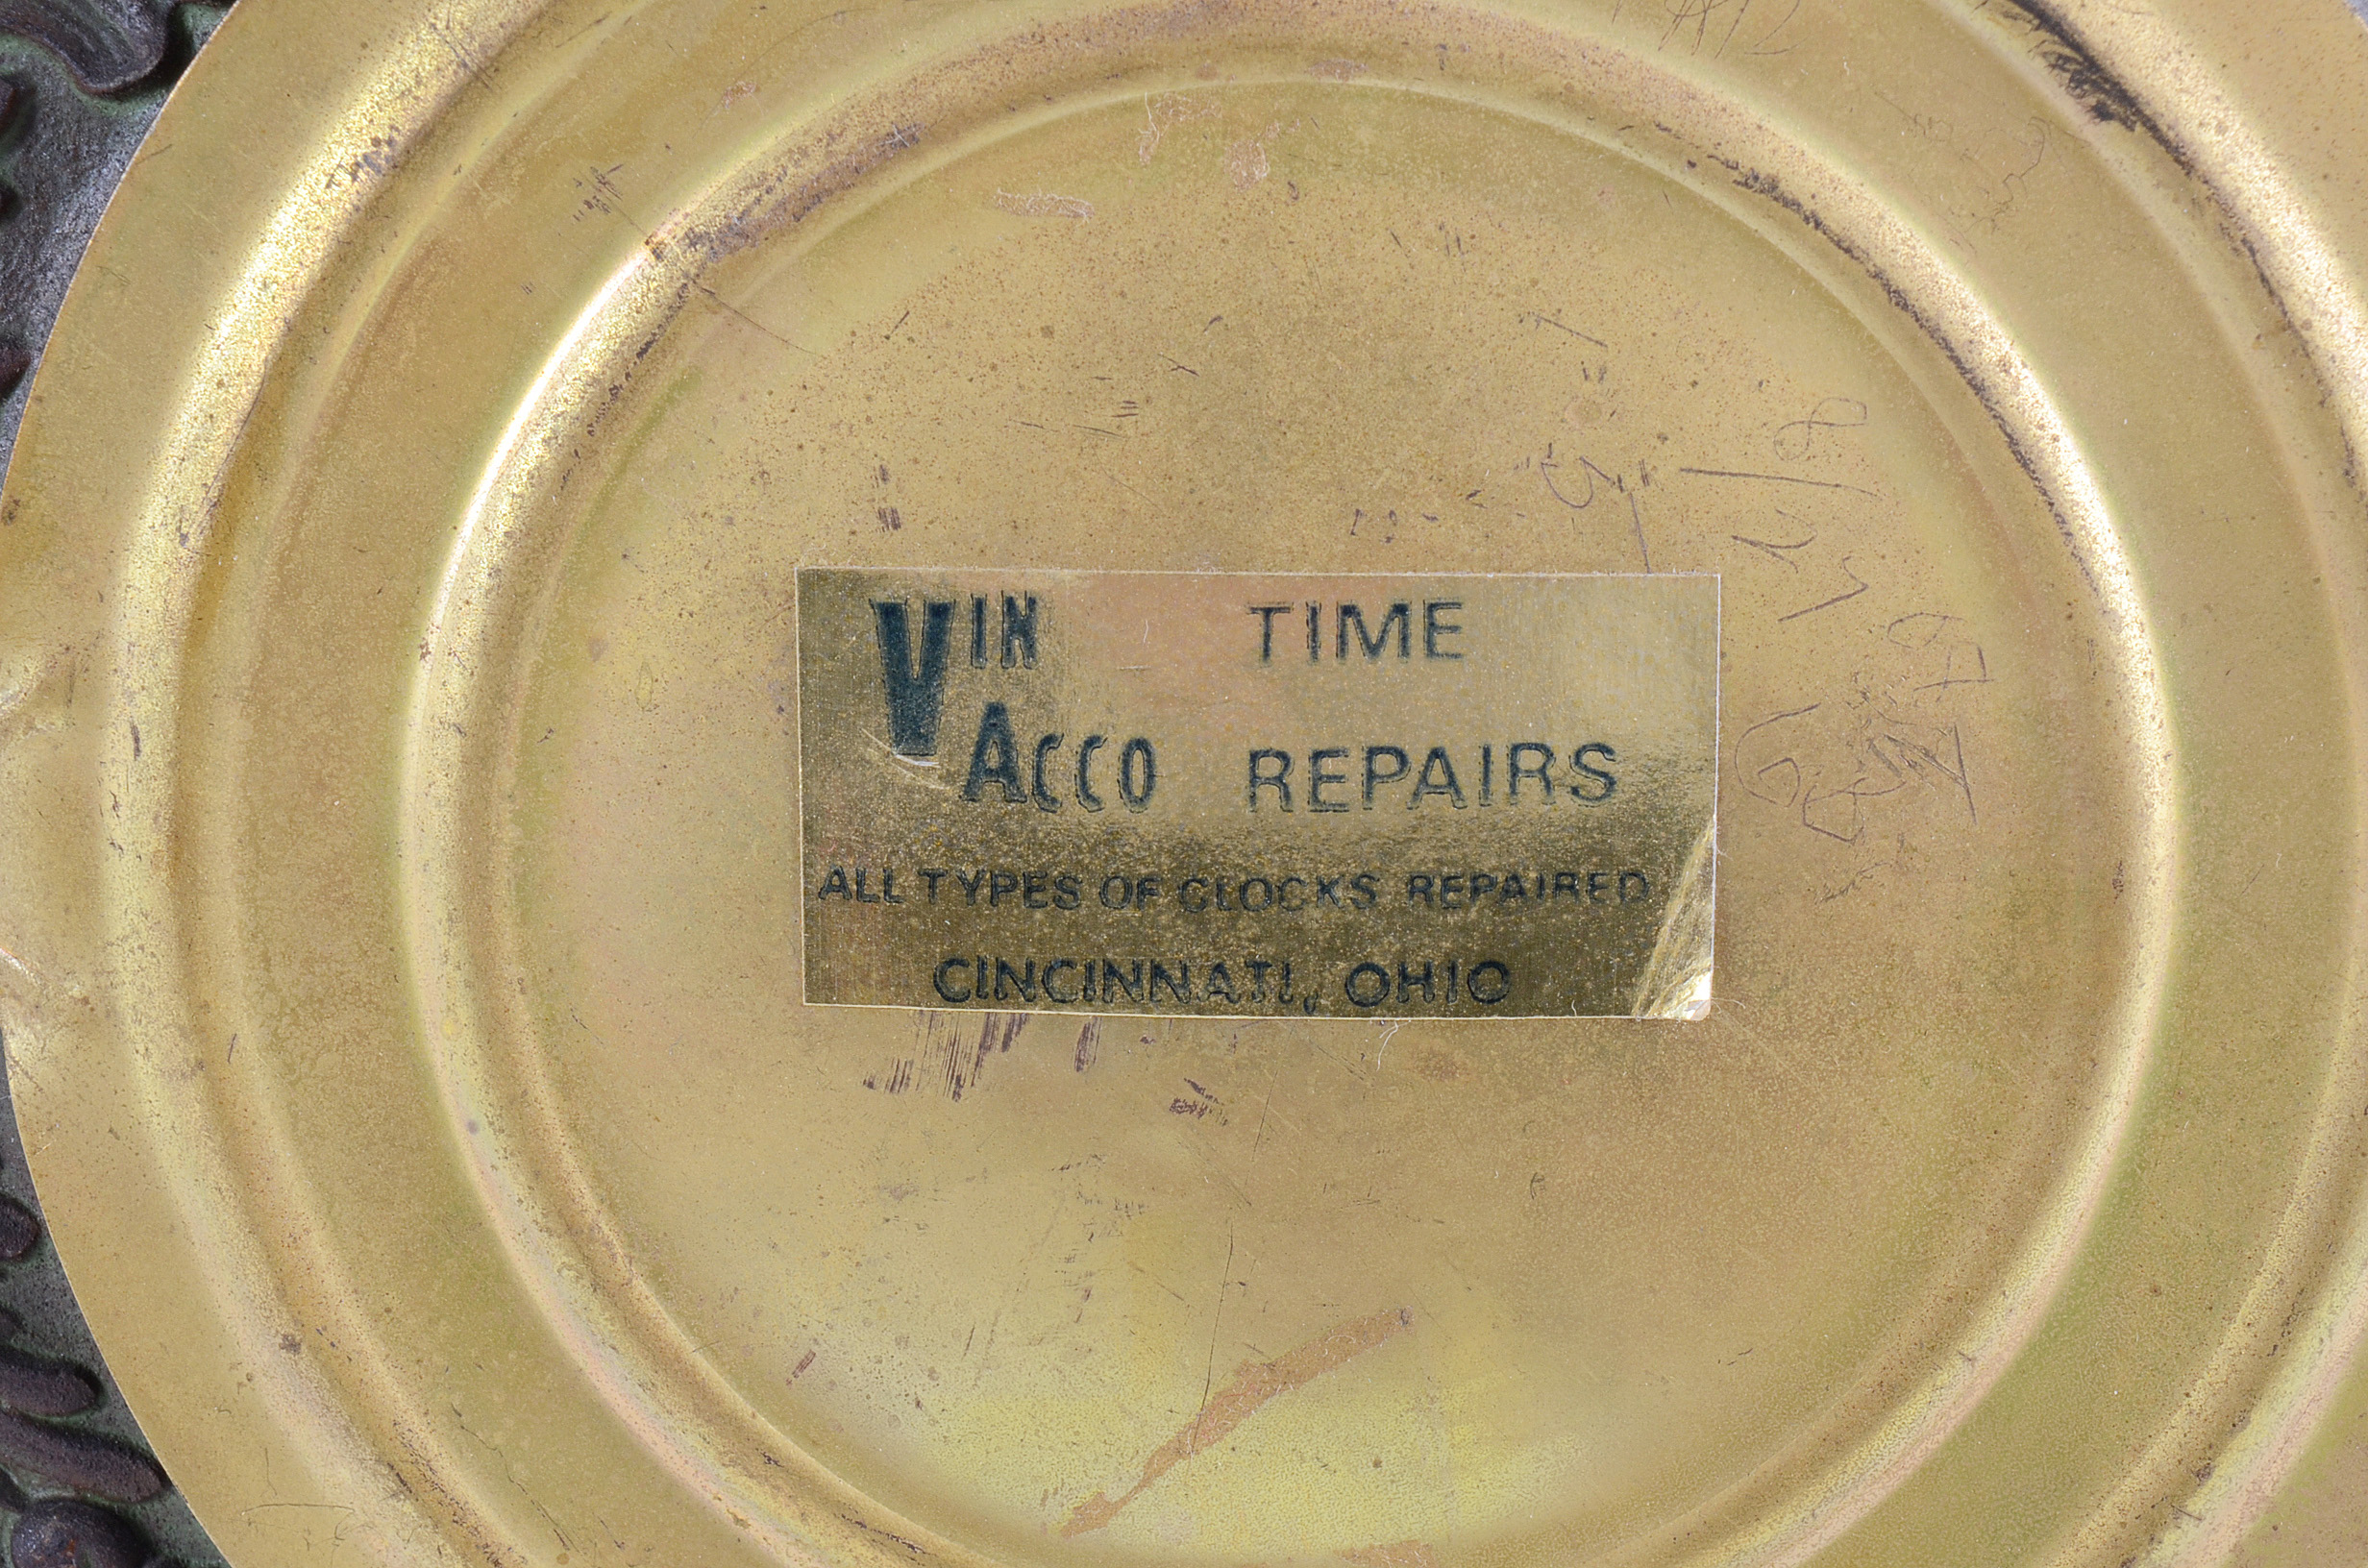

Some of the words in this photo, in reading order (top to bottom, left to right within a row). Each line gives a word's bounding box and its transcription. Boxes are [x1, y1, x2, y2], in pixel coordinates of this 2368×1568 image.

[1246, 599, 1465, 666] TIME
[1246, 741, 1618, 814] REPAIRS
[817, 865, 904, 904] ALL
[916, 868, 1083, 912] TYPES
[1098, 872, 1164, 912] OF
[1176, 872, 1381, 914] CLOCKS
[1406, 870, 1651, 909] REPAIRED
[932, 956, 1319, 1015] CINCINNATI,
[1344, 961, 1512, 1009] OHIO
